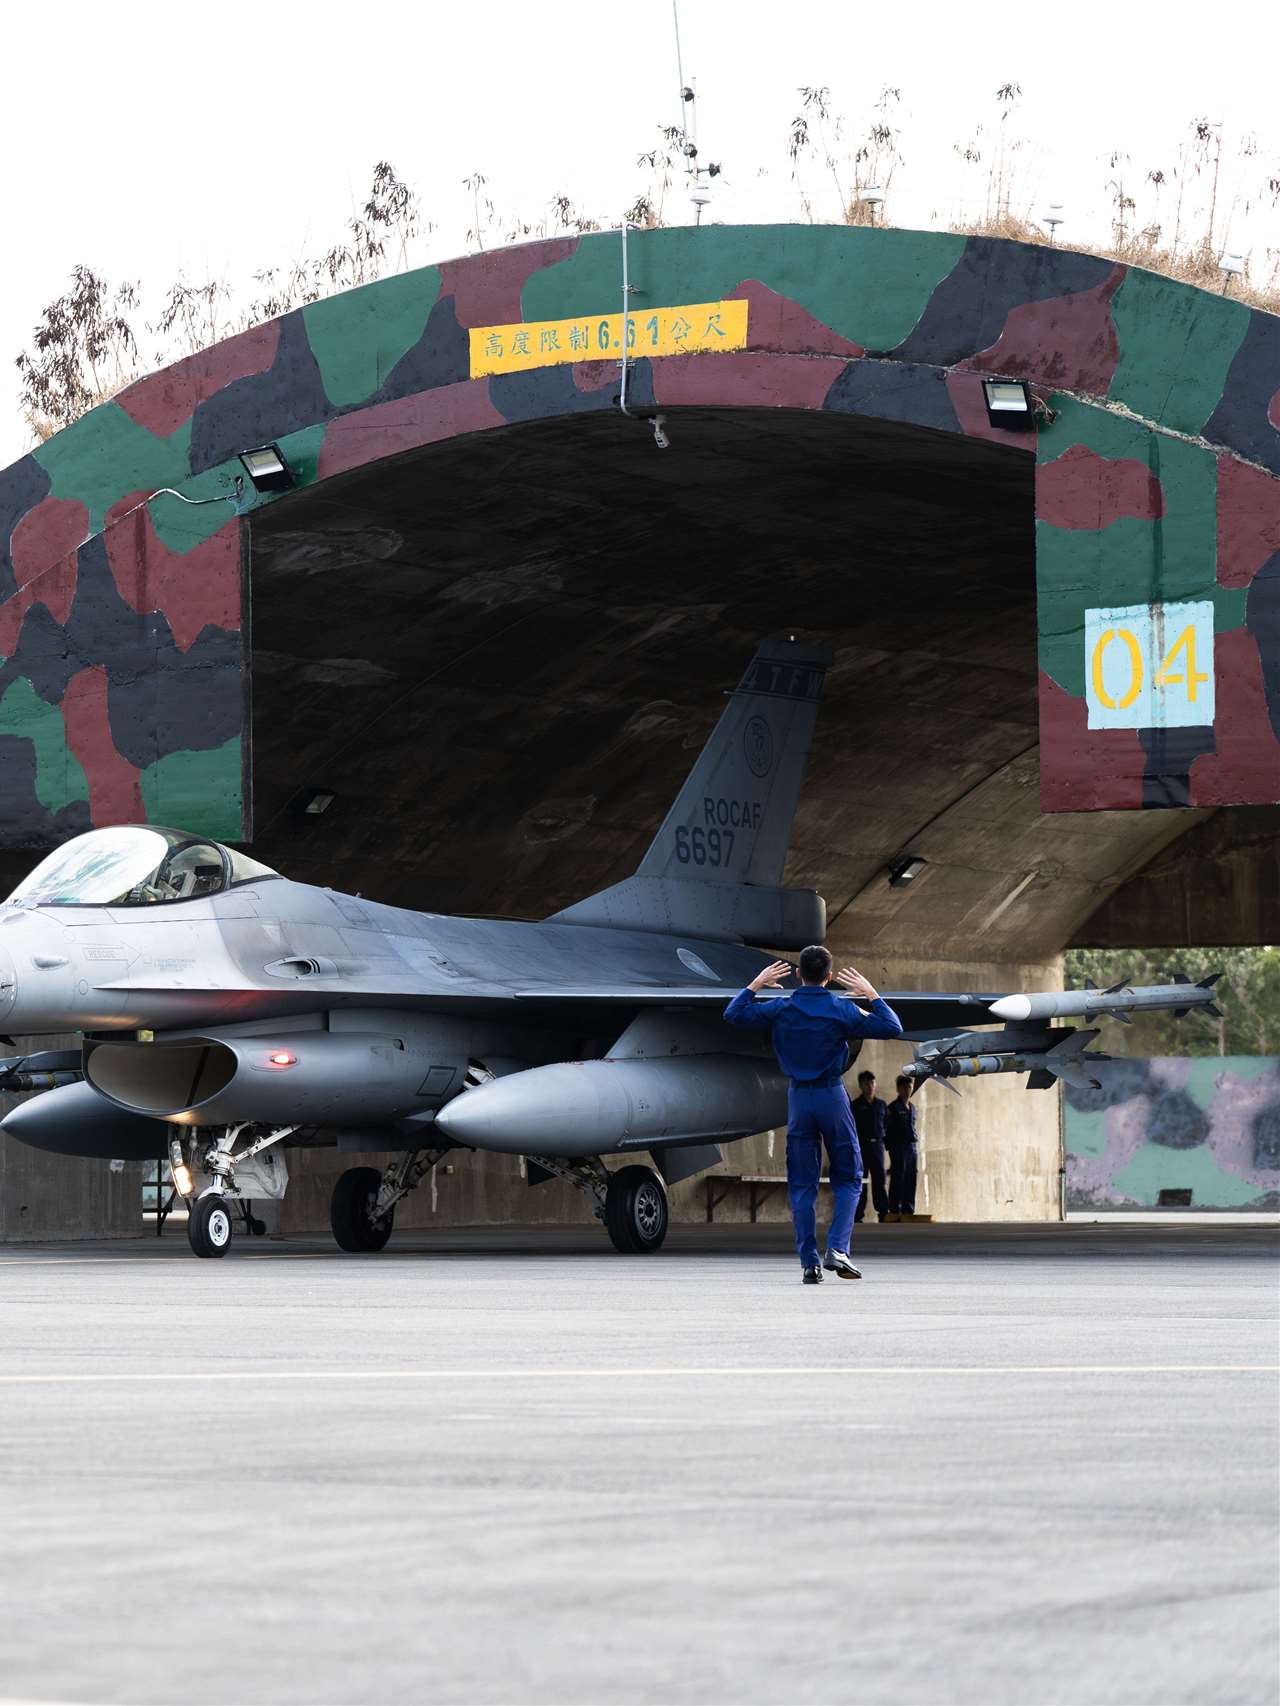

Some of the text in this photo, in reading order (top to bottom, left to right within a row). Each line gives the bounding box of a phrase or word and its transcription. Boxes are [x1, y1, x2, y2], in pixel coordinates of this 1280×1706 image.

[1092, 624, 1209, 710] 04
[704, 797, 761, 830] ROCAF
[675, 825, 735, 867] 6697
